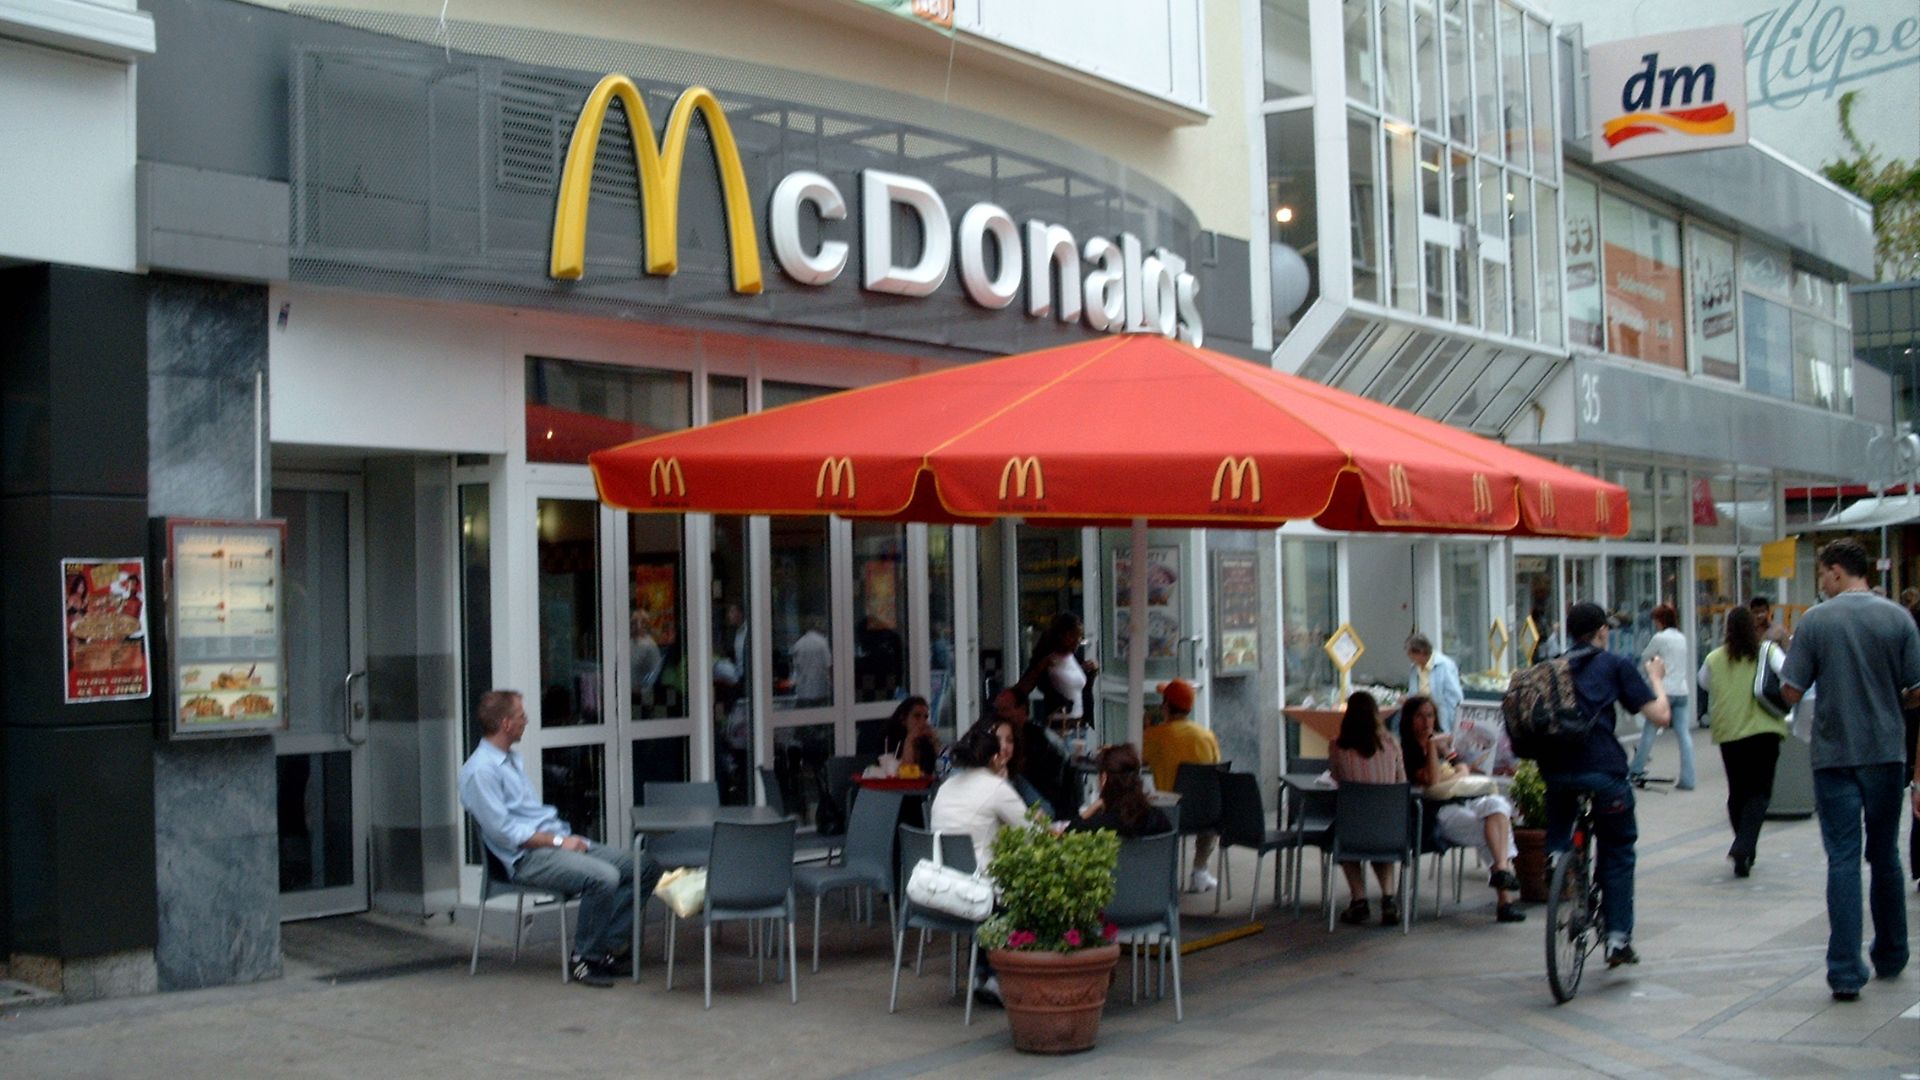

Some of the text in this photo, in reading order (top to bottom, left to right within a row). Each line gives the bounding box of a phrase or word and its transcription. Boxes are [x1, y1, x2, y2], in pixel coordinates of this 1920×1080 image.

[1621, 52, 1717, 113] dm
[550, 73, 1204, 349] McDonald's
[1582, 372, 1601, 425] 35
